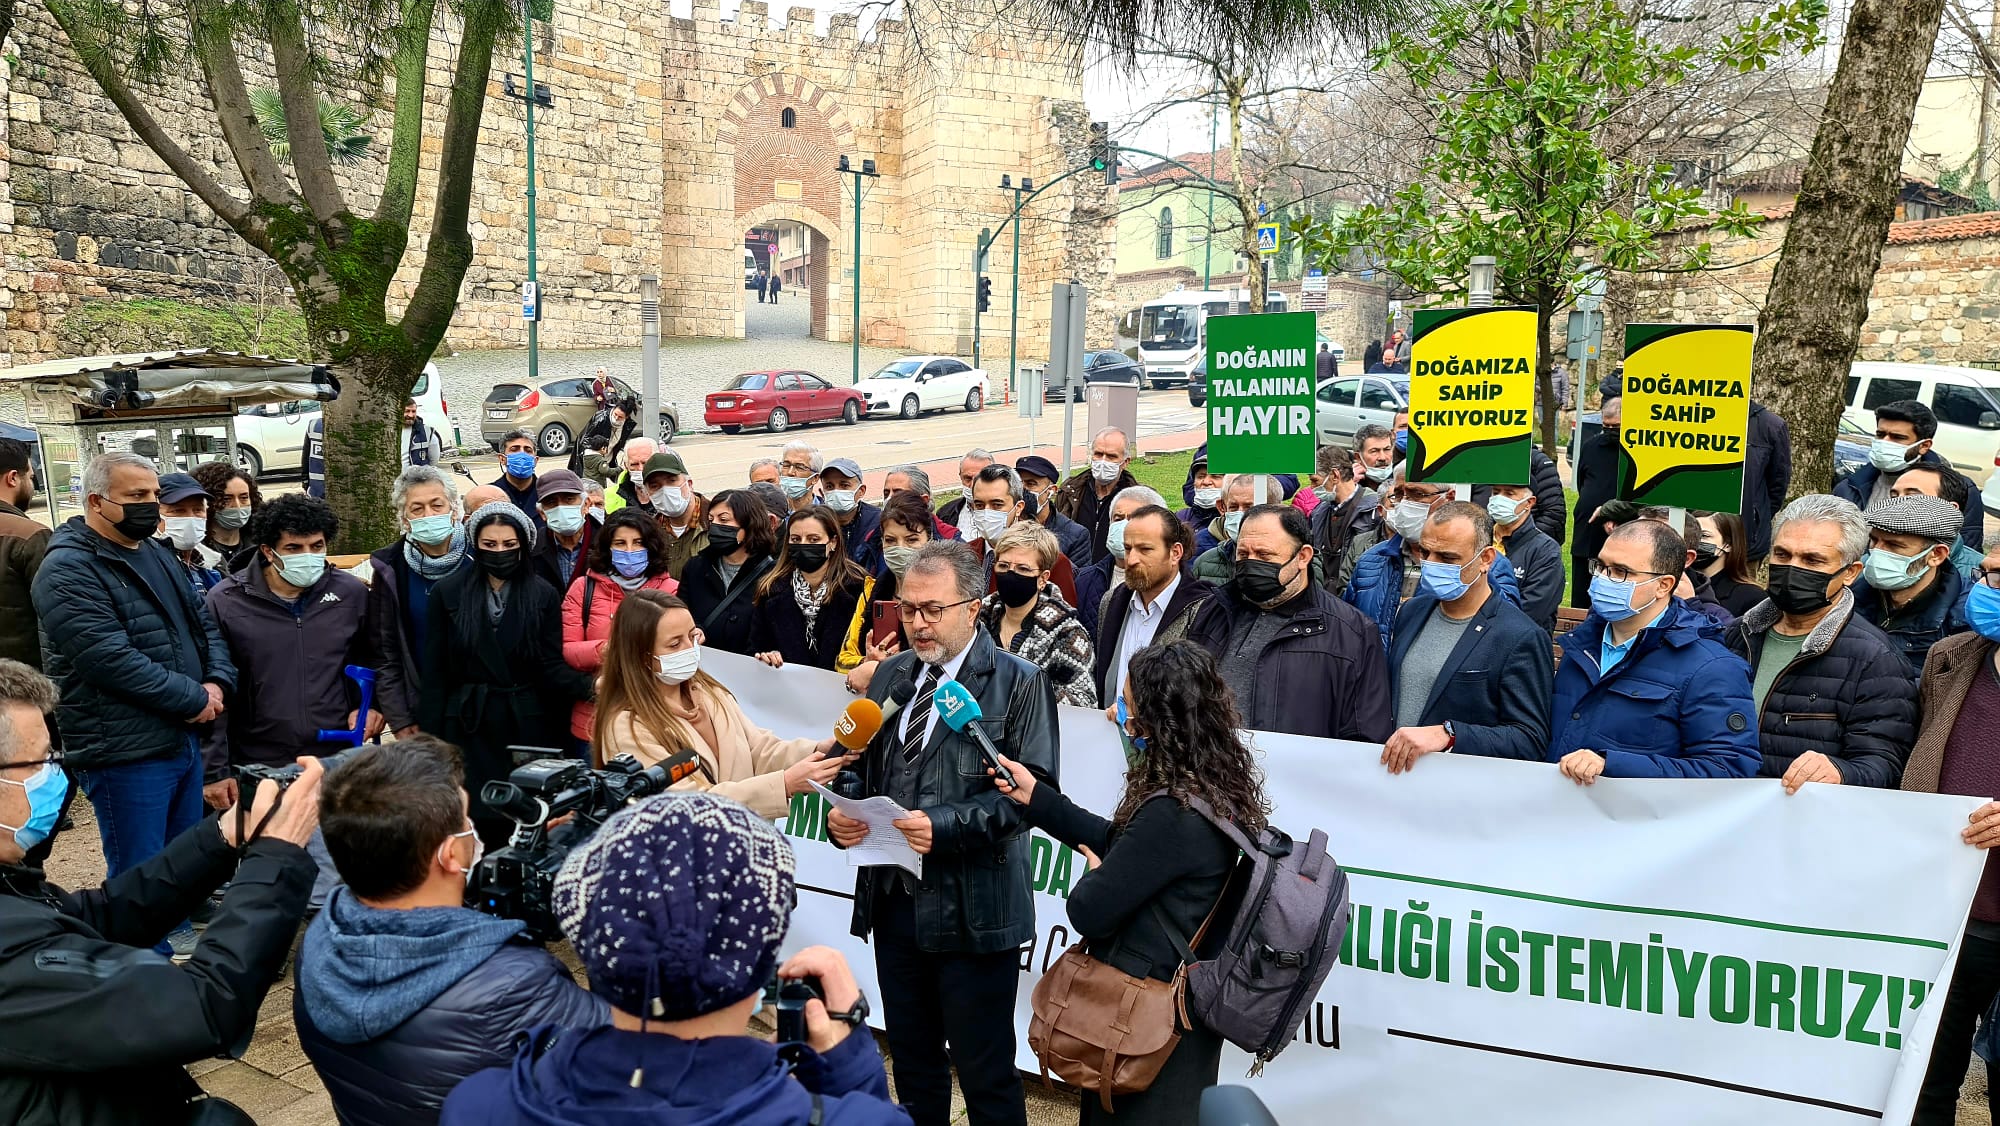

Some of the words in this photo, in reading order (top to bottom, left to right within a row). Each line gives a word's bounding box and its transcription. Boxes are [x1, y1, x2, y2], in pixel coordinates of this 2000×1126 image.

[1216, 345, 1306, 370] DOĞANIN
[1415, 355, 1530, 377] DOĞAMIZA
[1212, 377, 1310, 397] TALANINA
[1439, 381, 1503, 401] SAHİP
[1627, 373, 1744, 398] DOĞAMIZA
[1212, 405, 1311, 436] HAYIR
[1413, 409, 1527, 430] ÇIKIYORUZ
[1650, 402, 1716, 424] SAHİP
[1624, 428, 1741, 453] ÇIKIYORUZ
